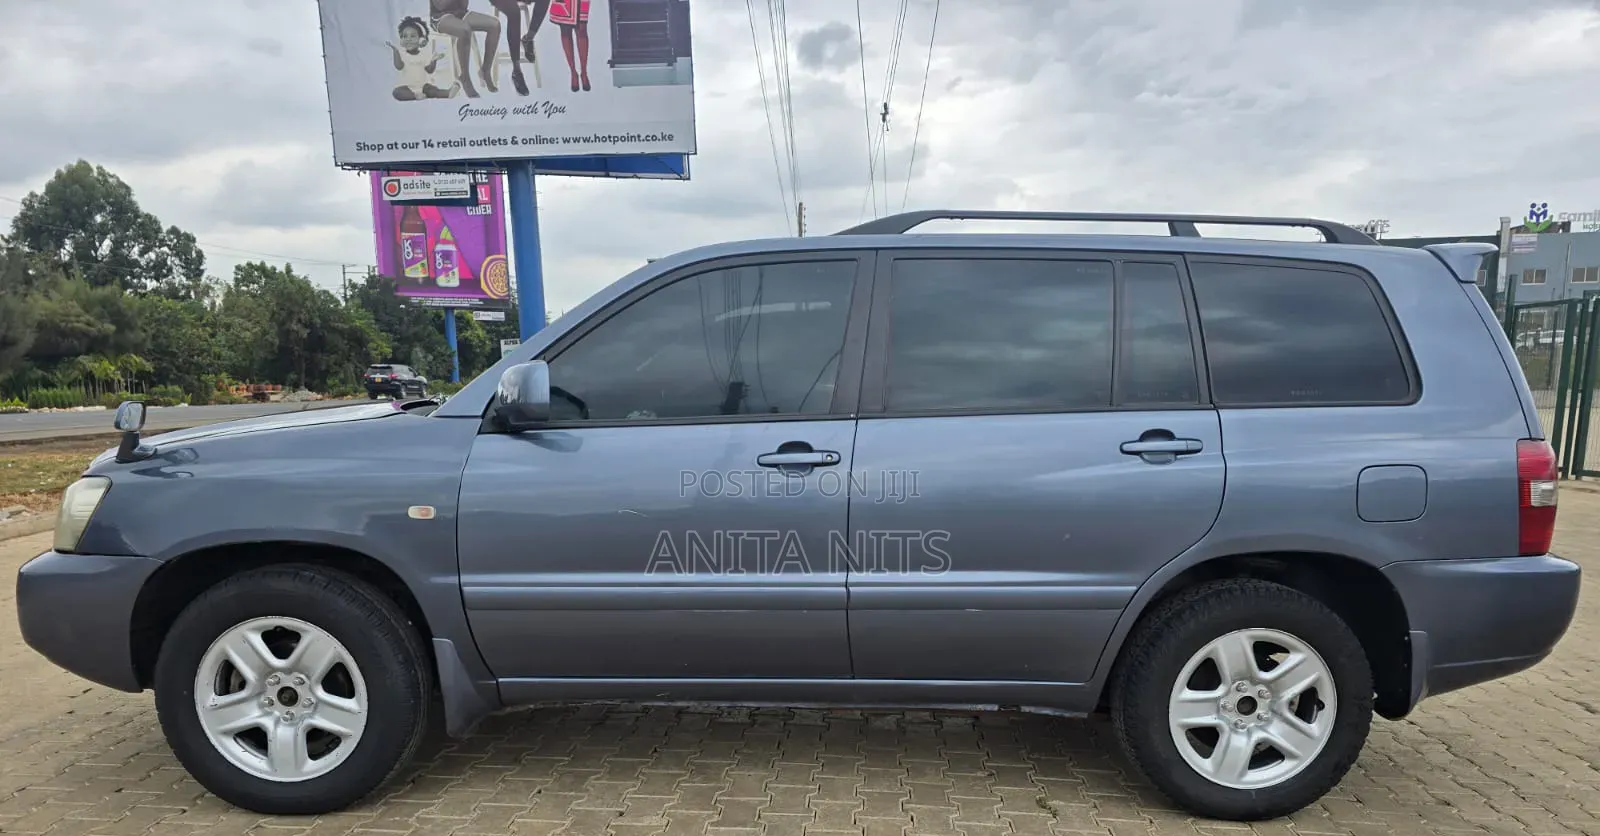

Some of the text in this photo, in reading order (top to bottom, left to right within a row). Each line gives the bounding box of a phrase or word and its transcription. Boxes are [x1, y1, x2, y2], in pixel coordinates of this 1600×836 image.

[458, 100, 566, 121] Growing with You
[356, 132, 674, 152] Shop at our 14 retail outlets & online: www.hotpoint.co.ke
[403, 180, 431, 190] adsite
[466, 204, 492, 215] CIDER
